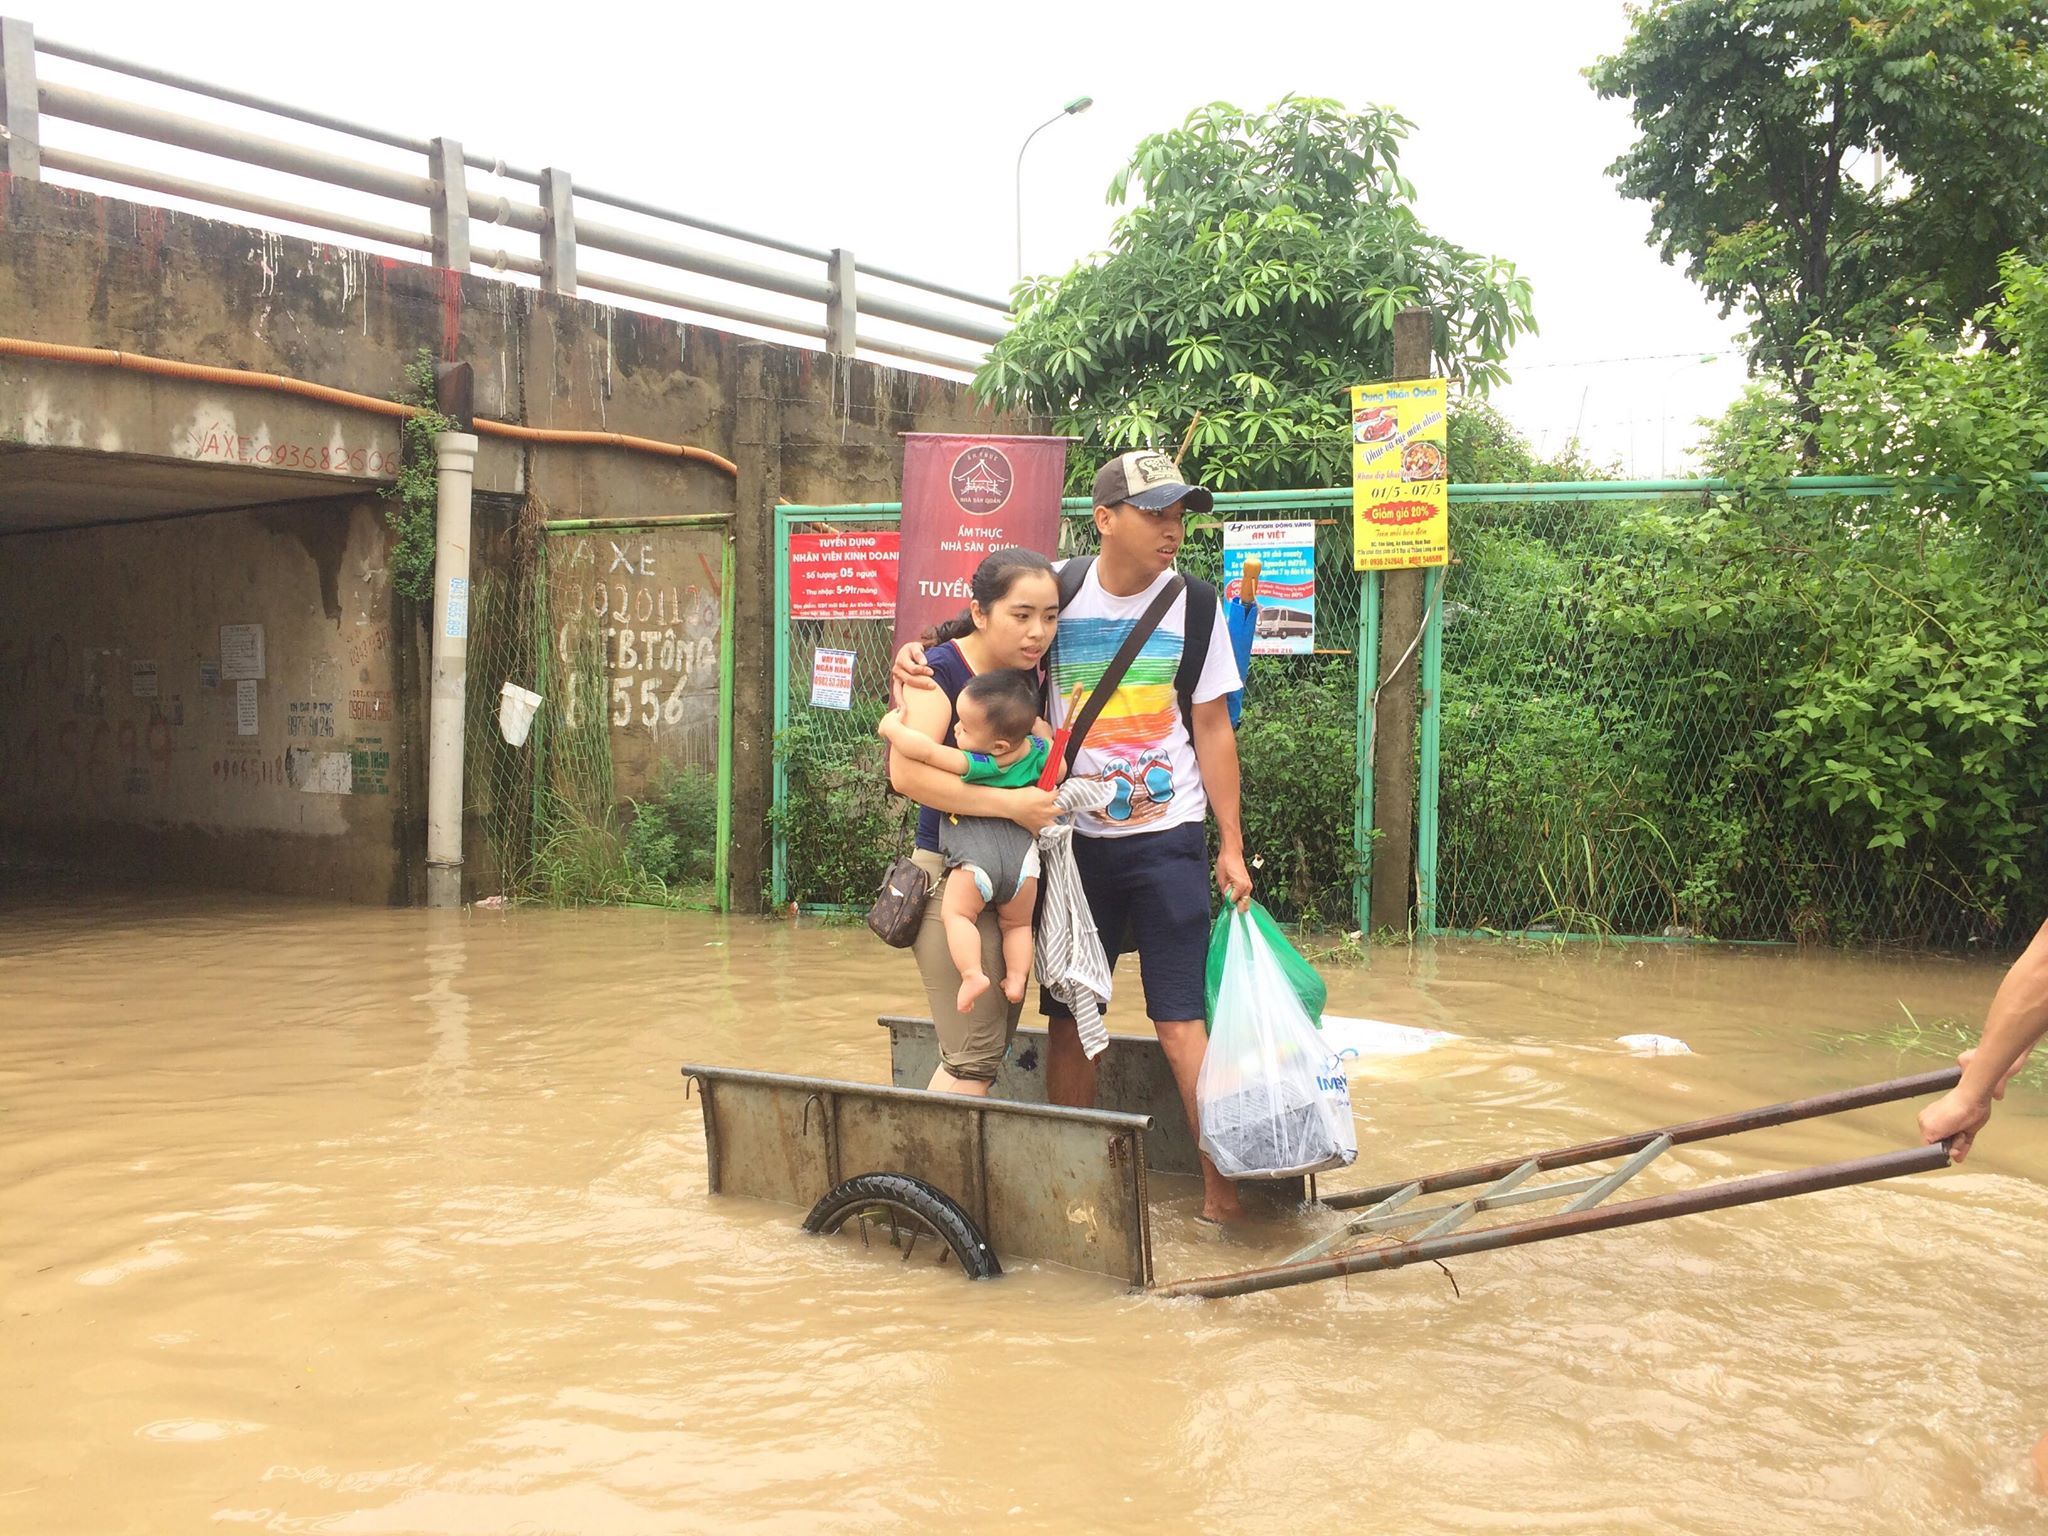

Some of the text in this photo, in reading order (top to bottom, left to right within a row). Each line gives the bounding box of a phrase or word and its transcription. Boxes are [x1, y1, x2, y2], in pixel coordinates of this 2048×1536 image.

[1371, 486, 1401, 500] 01/5
[1412, 482, 1441, 497] 07/5
[1371, 505, 1430, 521] Giảm giá 20%
[958, 524, 1004, 540] ẨM THỰC
[1252, 530, 1286, 540] AN VIỆT
[819, 535, 876, 548] TUYỂN DỤNG
[941, 540, 962, 551] NHÀ
[964, 541, 984, 552] SÀN
[793, 551, 900, 562] NHÂN VIÊN KINH DOAN
[840, 567, 854, 578] 05
